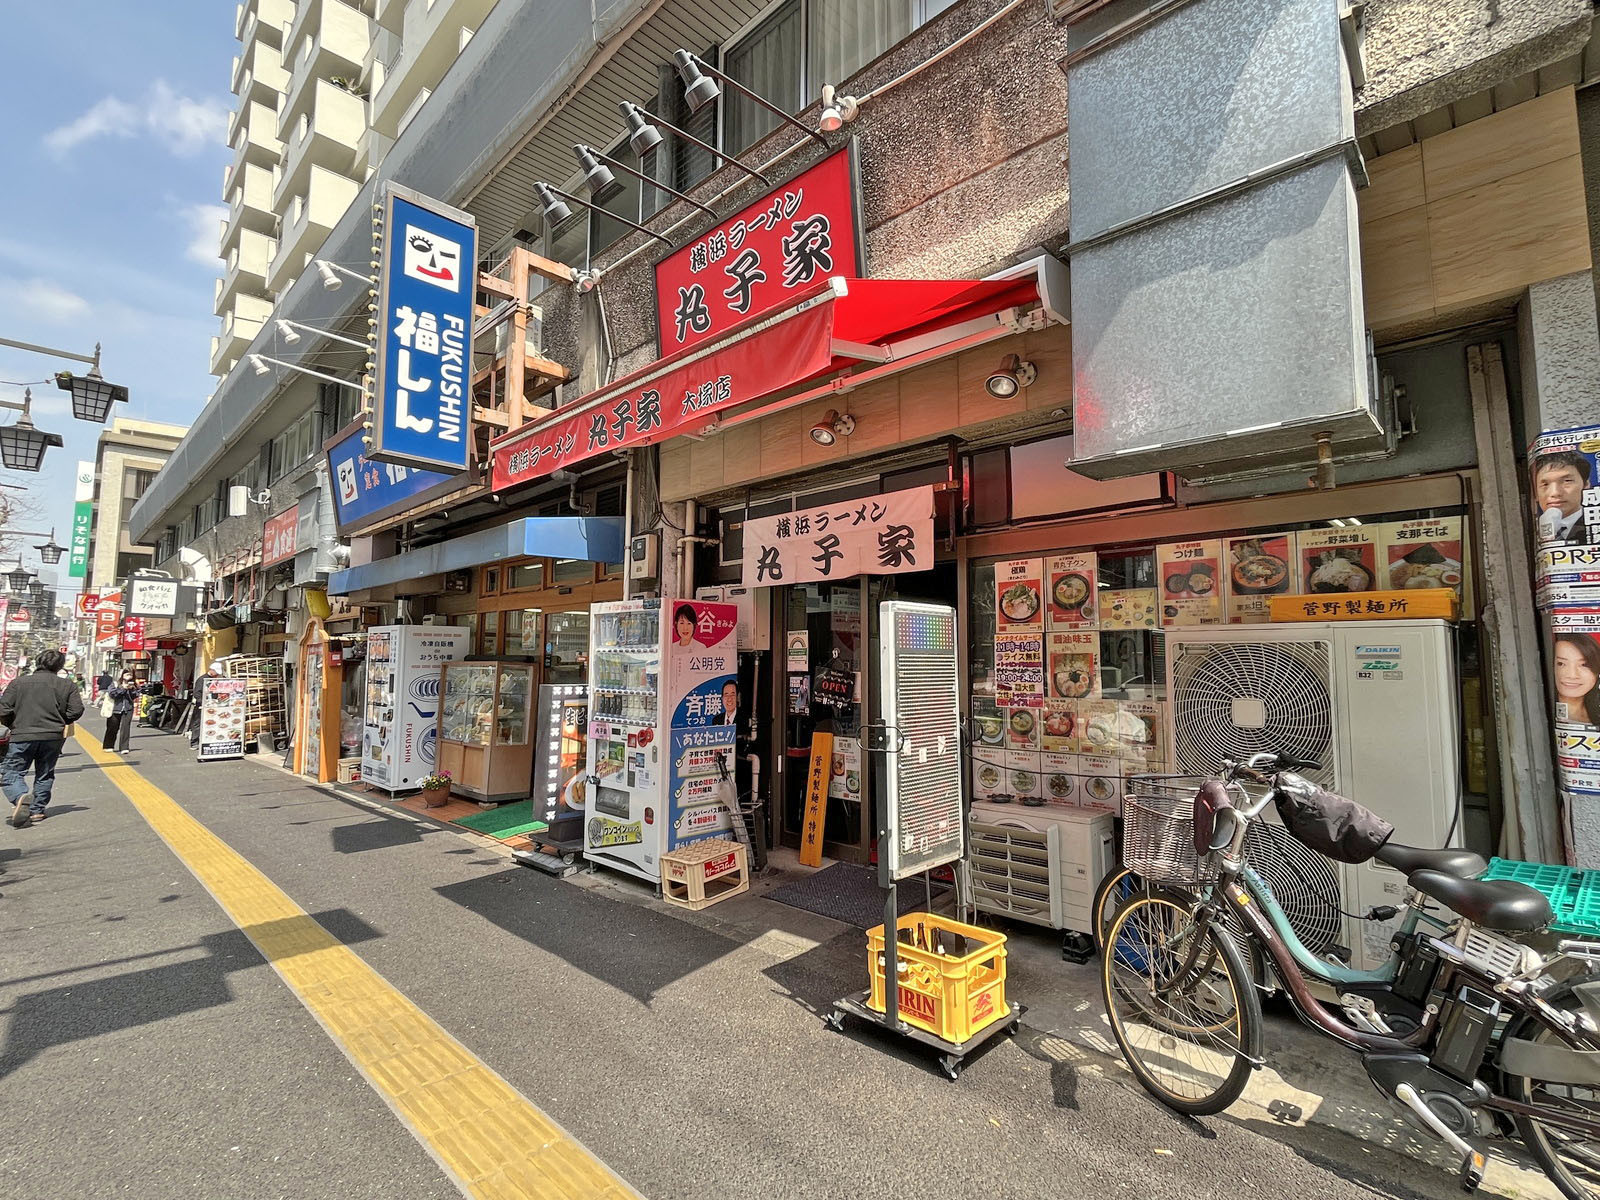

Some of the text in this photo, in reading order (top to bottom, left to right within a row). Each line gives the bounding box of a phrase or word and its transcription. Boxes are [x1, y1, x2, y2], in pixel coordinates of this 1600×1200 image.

[690, 188, 804, 273] 横浜ラーメン
[674, 214, 833, 343] 丸子家
[394, 305, 439, 434] 福しん
[438, 313, 464, 442] FUKUSHIN
[508, 375, 732, 475] 横浜ラーメン 丸子家 大塚店
[776, 501, 888, 539] 横浜ラーメン
[1396, 526, 1449, 540] 支那そば
[72, 515, 88, 565] りそな銀行
[757, 524, 916, 582] 丸子家
[1174, 548, 1204, 559] つけ麺
[1328, 534, 1369, 544] 野菜増し
[697, 610, 734, 634] 谷 きみよ
[1302, 599, 1408, 616] 菅野製麺所
[689, 656, 725, 671] 公明党
[822, 680, 848, 693] OPEN
[686, 693, 722, 717] 斉藤
[686, 717, 706, 725] てつお
[405, 723, 413, 764] FUKUSHIN
[807, 755, 823, 845] 菅野製麺所 特製
[898, 986, 935, 1017] IRIN
